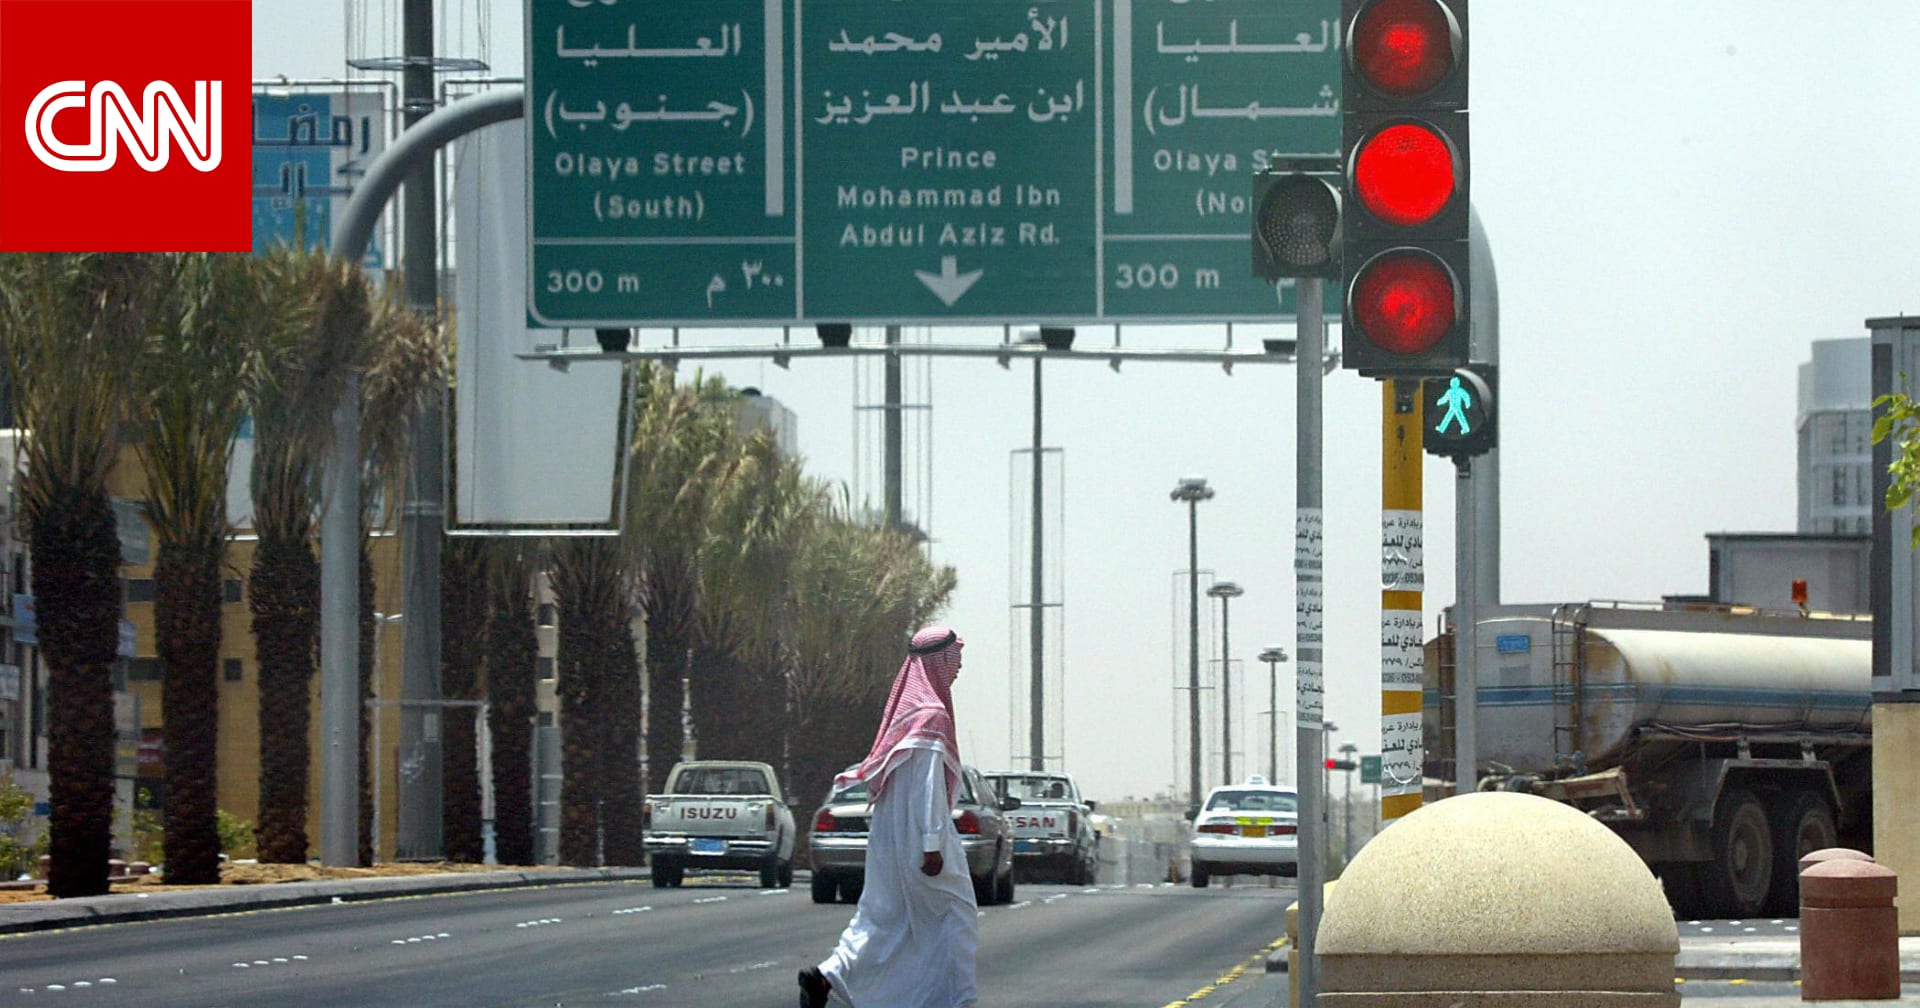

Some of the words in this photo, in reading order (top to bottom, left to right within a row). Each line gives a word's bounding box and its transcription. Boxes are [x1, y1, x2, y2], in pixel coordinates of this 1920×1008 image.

[556, 22, 742, 67] العليا
[828, 28, 943, 56] محمد
[963, 6, 1069, 61] الأمير
[1156, 18, 1341, 63] العليا
[814, 80, 931, 125] العزيز
[940, 90, 1016, 123] عبد
[1027, 79, 1085, 123] ابن
[554, 151, 639, 181] Olaya
[653, 152, 746, 175] Street
[901, 146, 997, 169] Prince
[1153, 149, 1237, 177] Olaya
[593, 190, 706, 221] (South)
[837, 185, 1001, 208] Mohammad
[1016, 184, 1061, 206] Ibn
[839, 223, 925, 247] Abdul
[939, 222, 1006, 246] Aziz
[1019, 222, 1060, 246] Rd.
[546, 270, 604, 293] 300
[617, 273, 640, 293] m
[741, 259, 784, 289] ٣٠٠
[1115, 263, 1179, 289] 300
[1195, 268, 1220, 289] m
[706, 273, 727, 309] م
[680, 807, 738, 820] ISUZU
